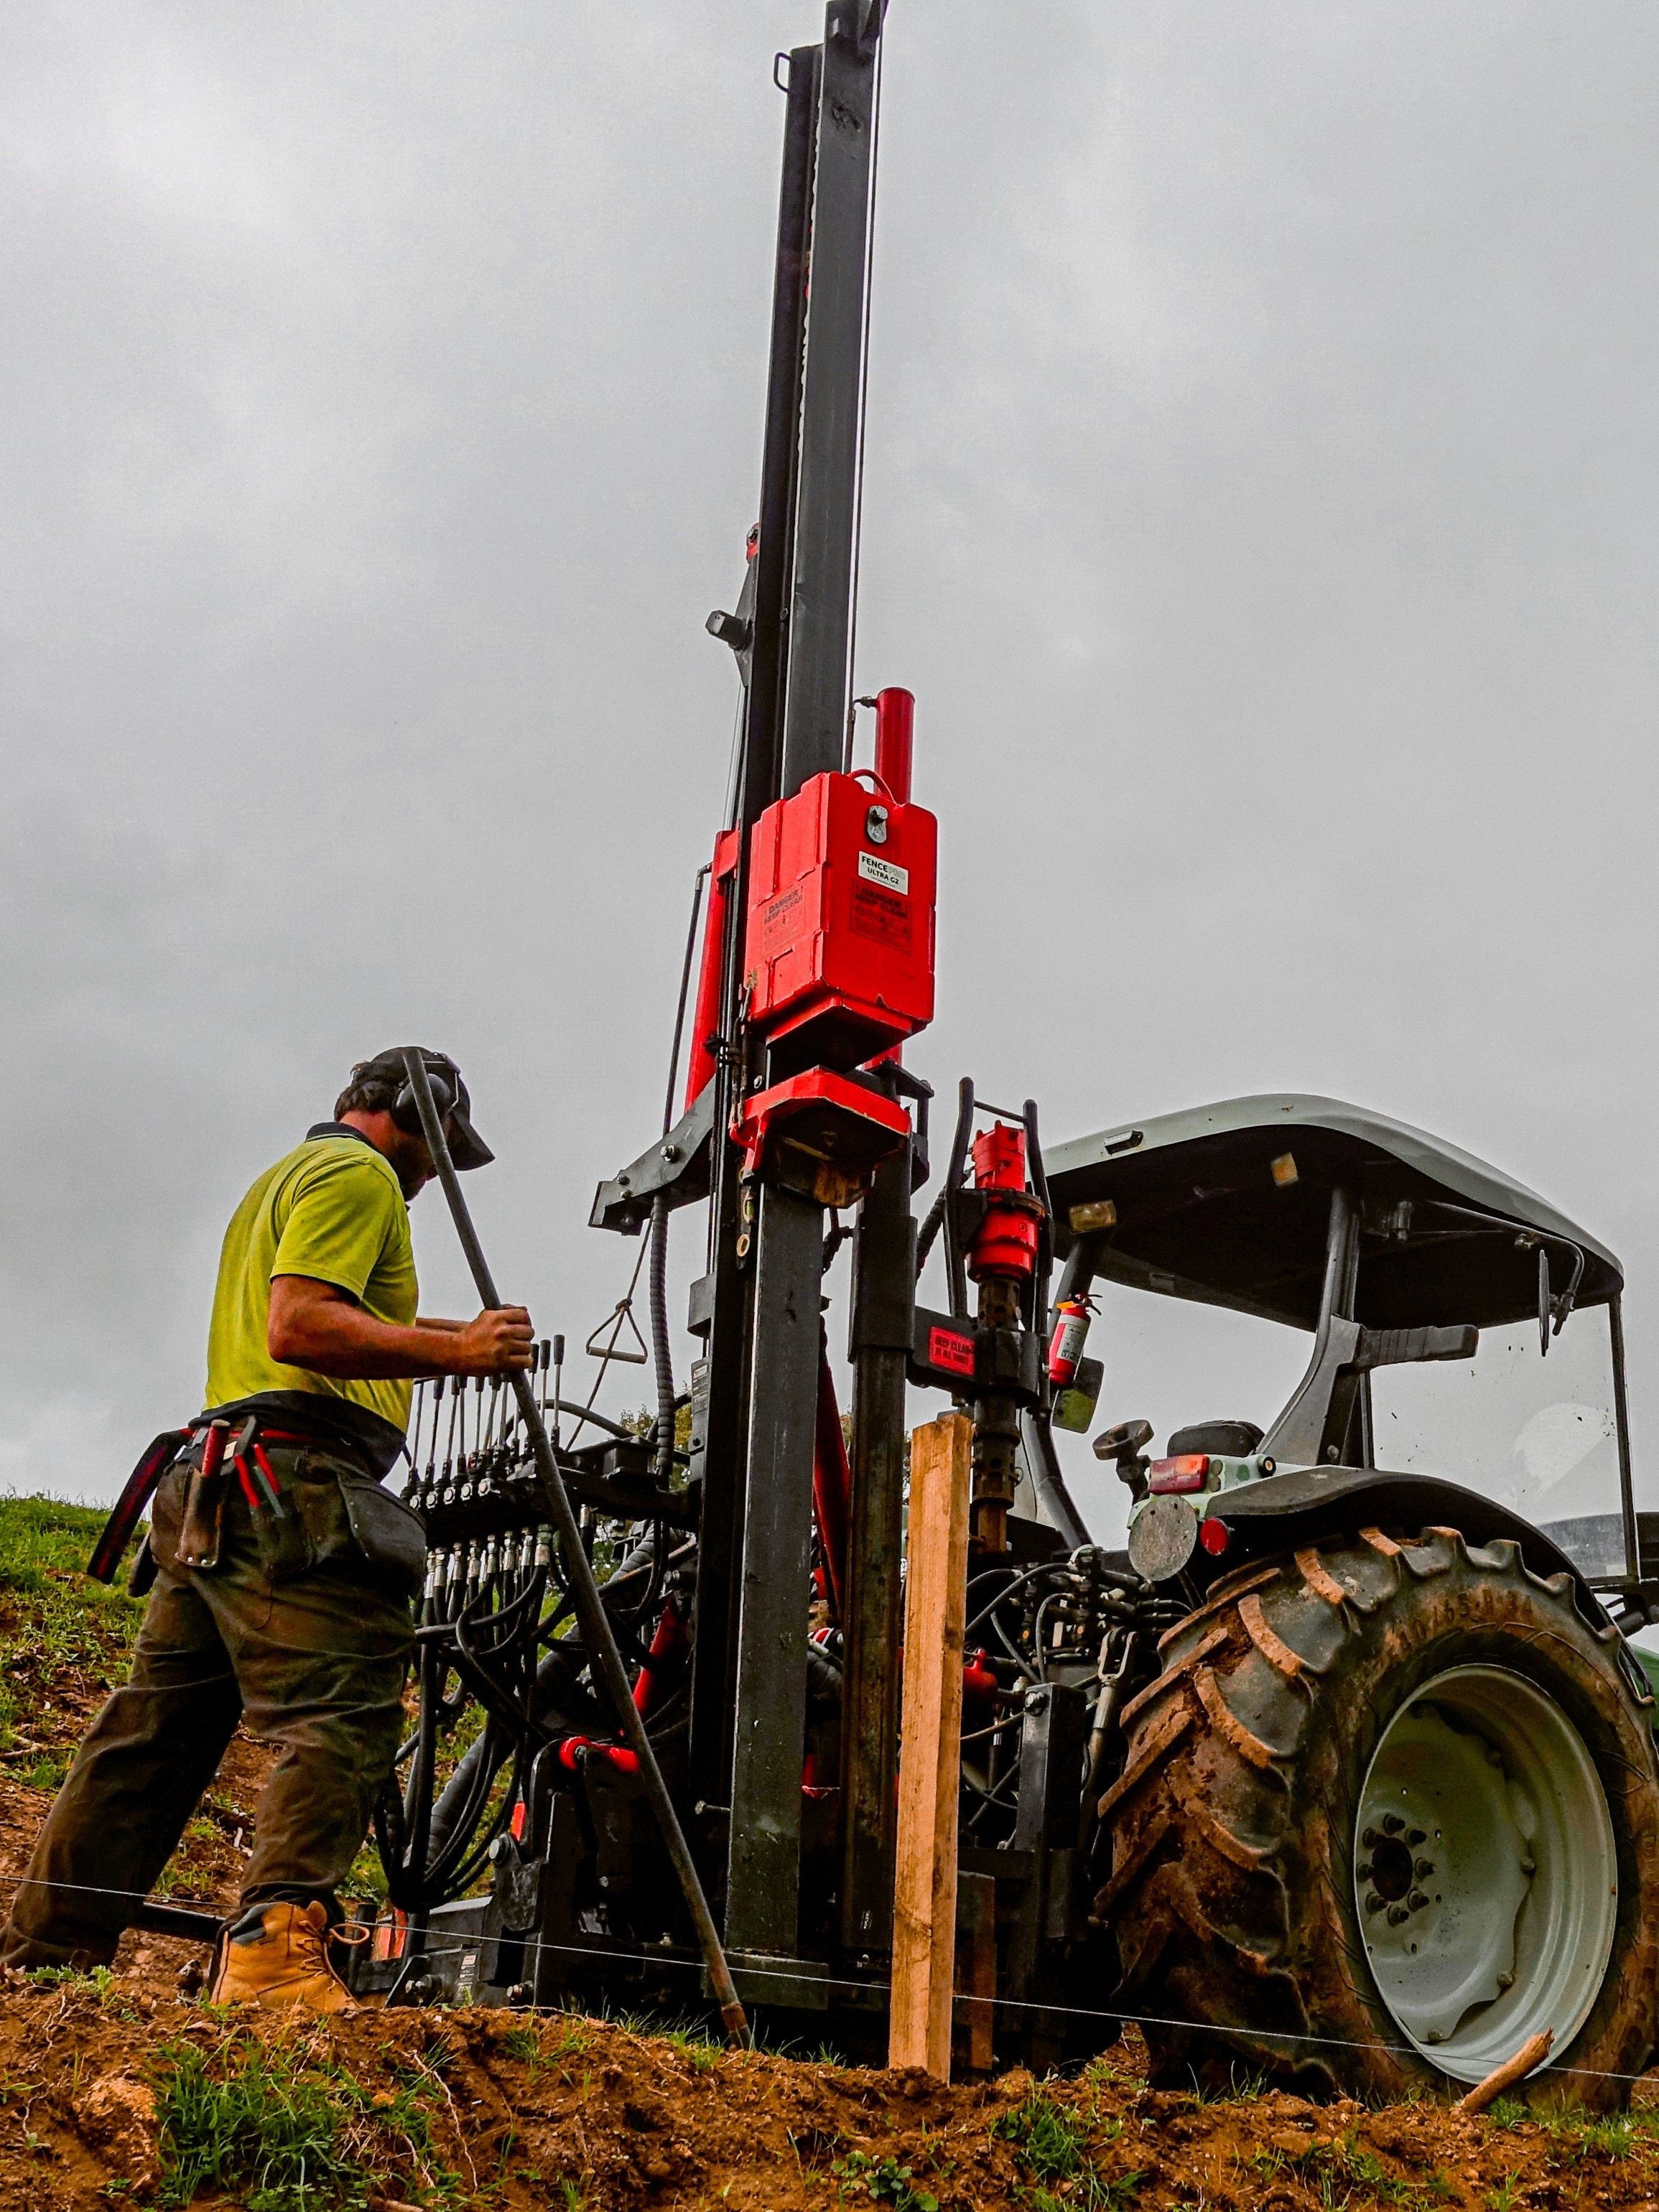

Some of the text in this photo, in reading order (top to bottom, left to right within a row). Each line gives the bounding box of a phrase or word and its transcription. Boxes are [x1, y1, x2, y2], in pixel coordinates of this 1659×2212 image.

[867, 867, 889, 880] ULTRA
[890, 876, 899, 885] G2
[768, 890, 799, 914] DANGER
